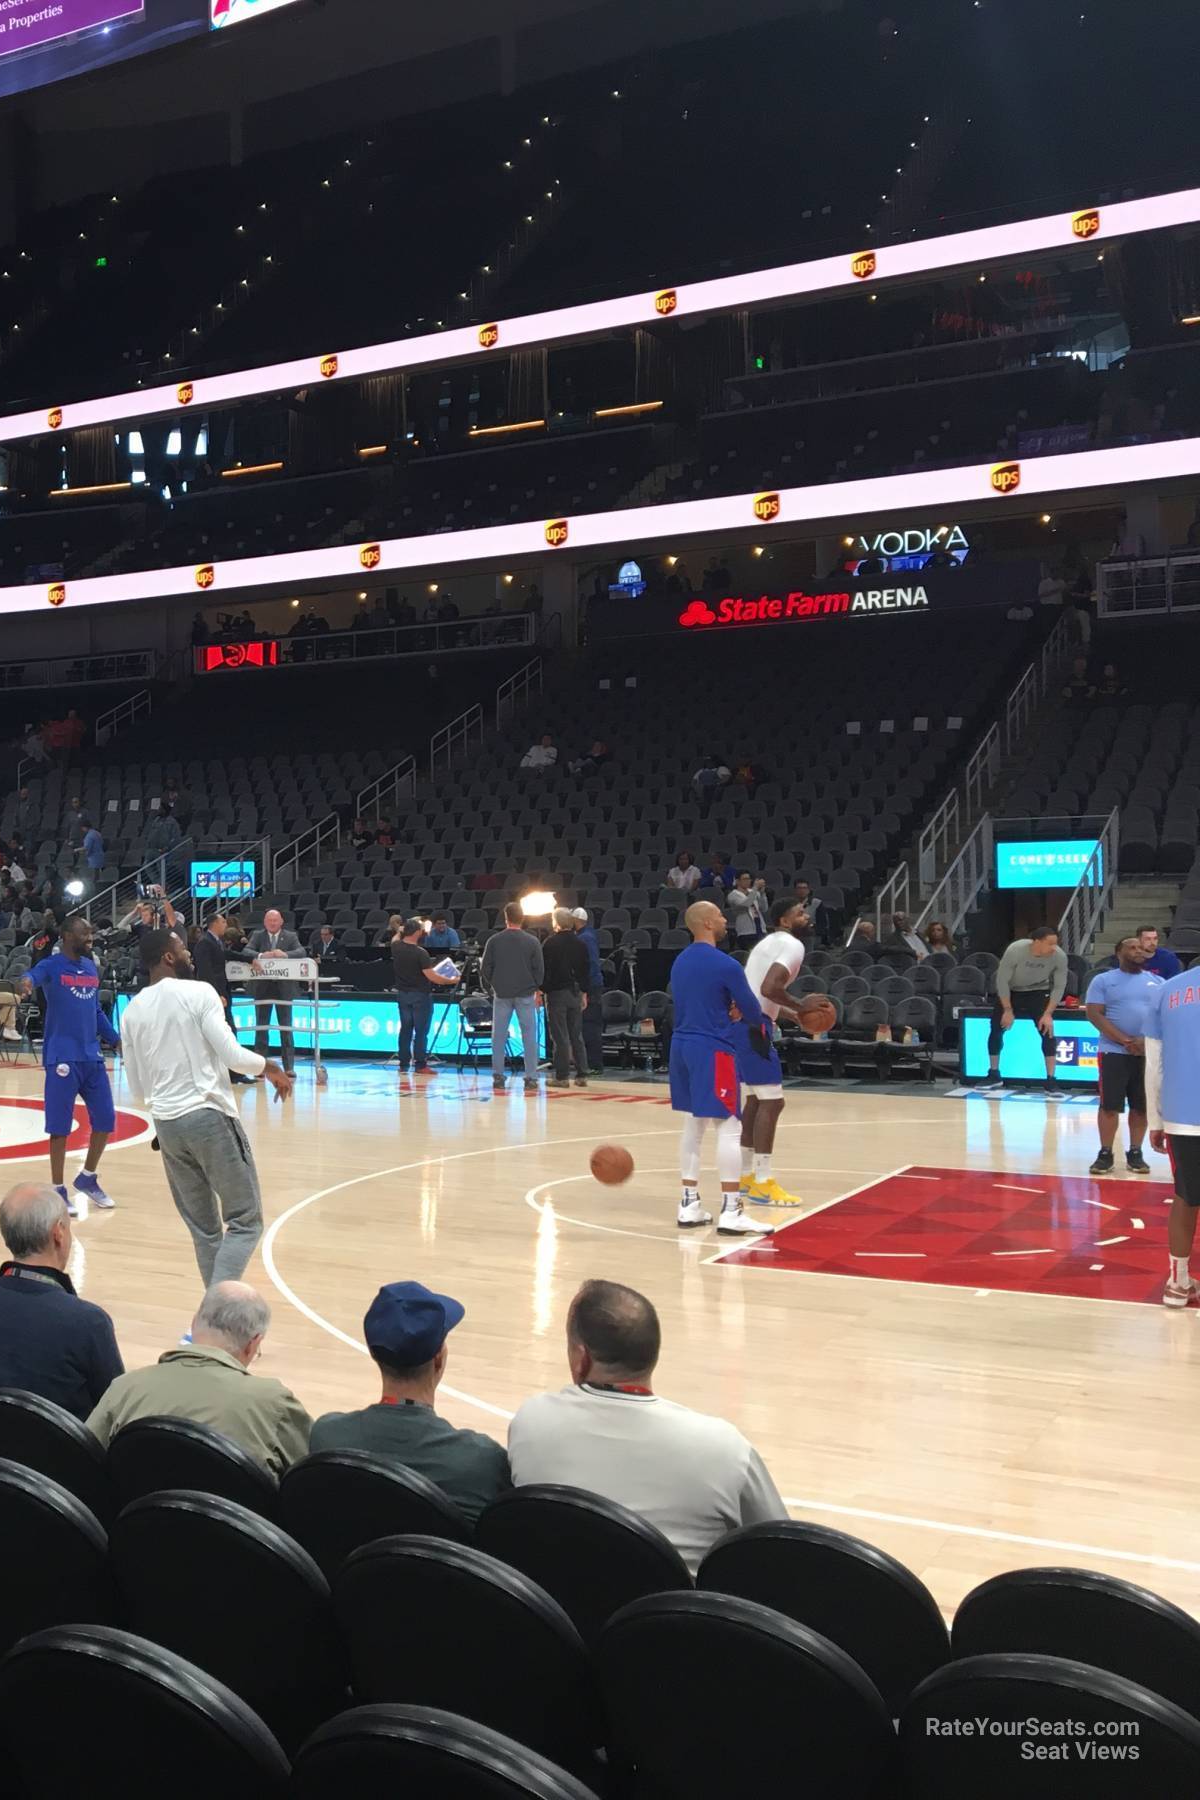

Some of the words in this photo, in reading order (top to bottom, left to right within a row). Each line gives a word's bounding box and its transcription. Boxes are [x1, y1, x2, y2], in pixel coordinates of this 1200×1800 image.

[8, 5, 63, 31] Properties
[1073, 217, 1099, 236] ups
[853, 258, 875, 275] ups
[656, 296, 676, 312] ups
[480, 330, 497, 344] ups
[321, 361, 337, 375] ups
[178, 389, 193, 402] ups
[49, 414, 62, 427] ups
[993, 471, 1019, 490] ups
[756, 501, 779, 518] ups
[546, 527, 567, 543] ups
[860, 525, 969, 555] VODKA
[361, 551, 380, 566] ups
[196, 572, 213, 586] ups
[49, 590, 65, 603] ups
[852, 586, 929, 611] ARENA
[1169, 986, 1200, 1009] HA
